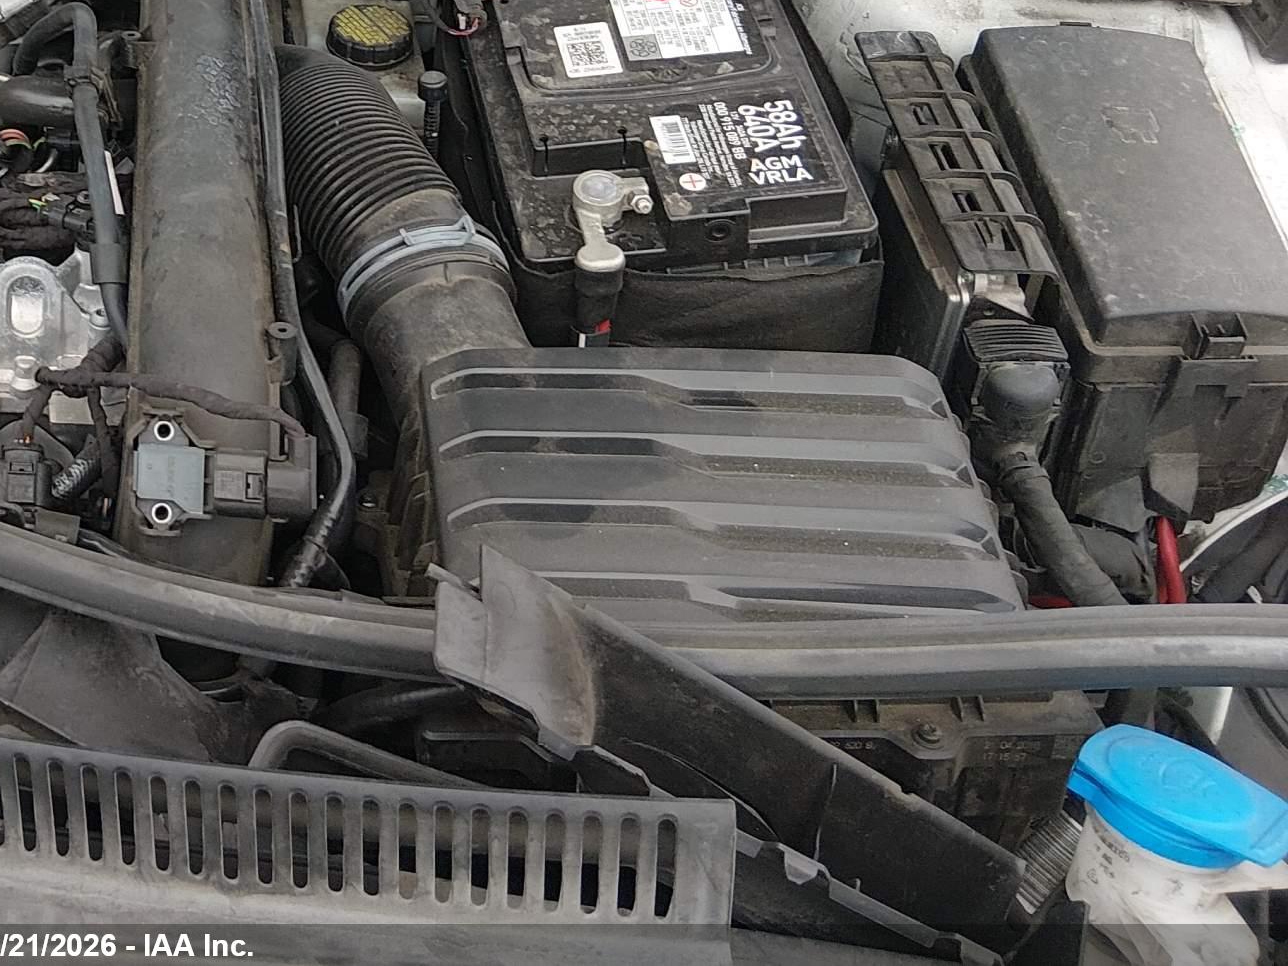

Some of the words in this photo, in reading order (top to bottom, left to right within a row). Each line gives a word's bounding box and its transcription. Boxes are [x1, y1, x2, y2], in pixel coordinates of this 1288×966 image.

[713, 101, 729, 116] 000
[719, 116, 737, 131] 915
[737, 104, 781, 153] 640A
[763, 99, 807, 150] 58Ah
[725, 131, 742, 146] 089
[750, 154, 803, 172] AGM
[747, 167, 815, 185] VRLA
